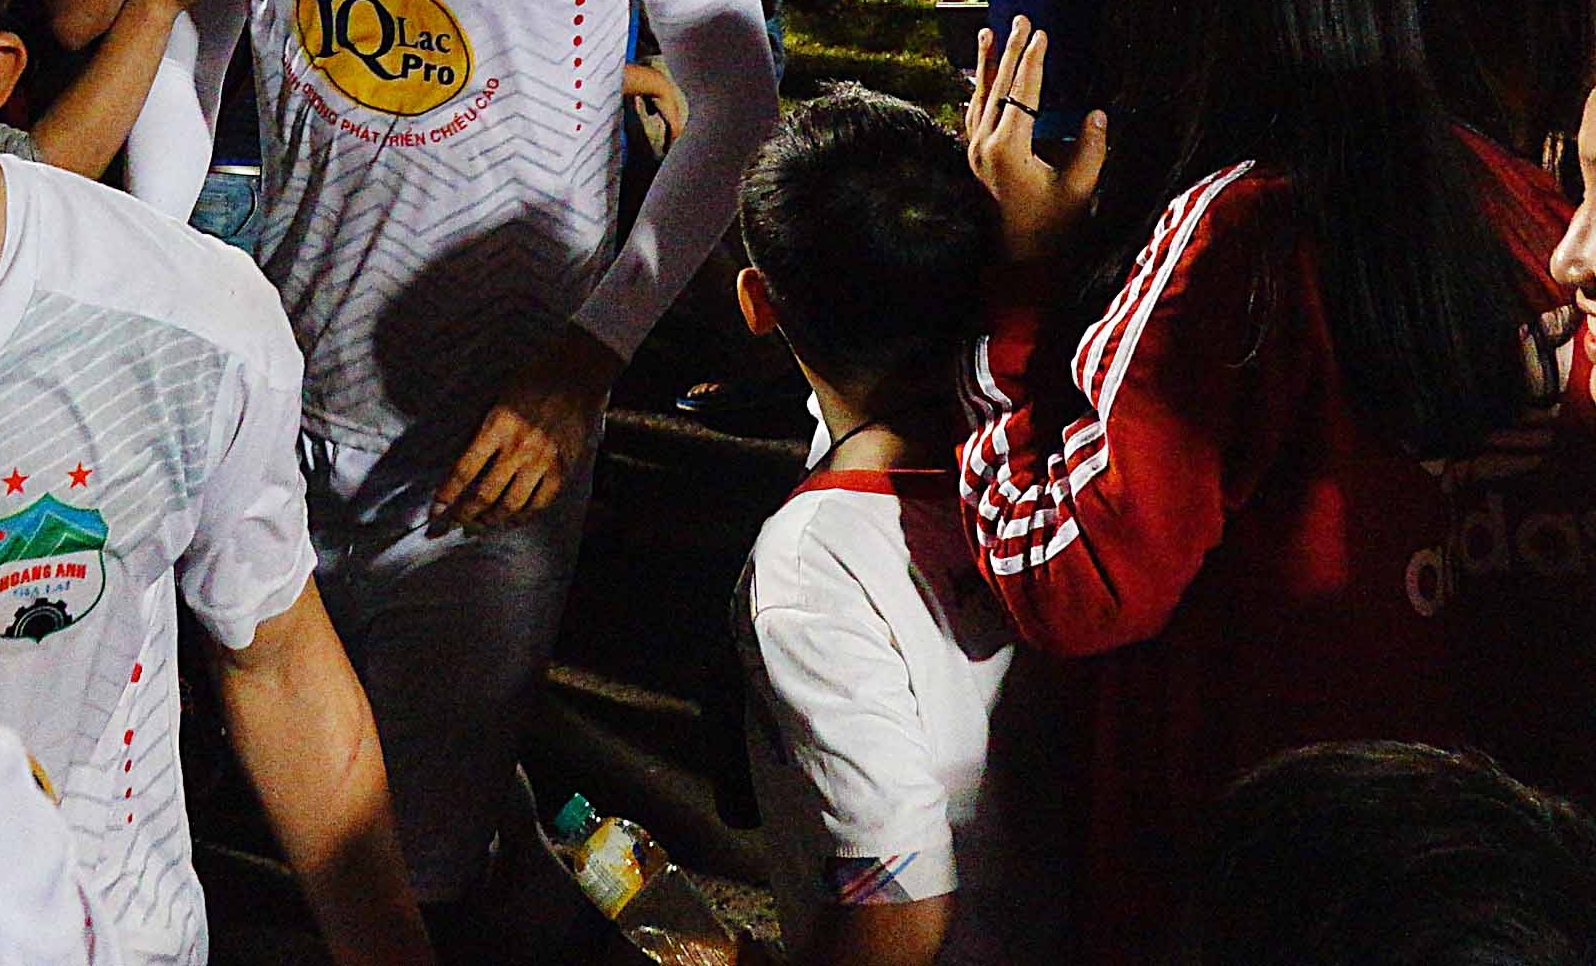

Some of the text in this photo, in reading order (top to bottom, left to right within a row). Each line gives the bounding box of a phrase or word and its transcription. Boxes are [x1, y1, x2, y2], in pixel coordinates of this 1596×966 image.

[396, 17, 451, 53] Lac
[402, 53, 454, 85] Pro
[475, 78, 500, 109] CAO
[55, 563, 87, 580] ANH
